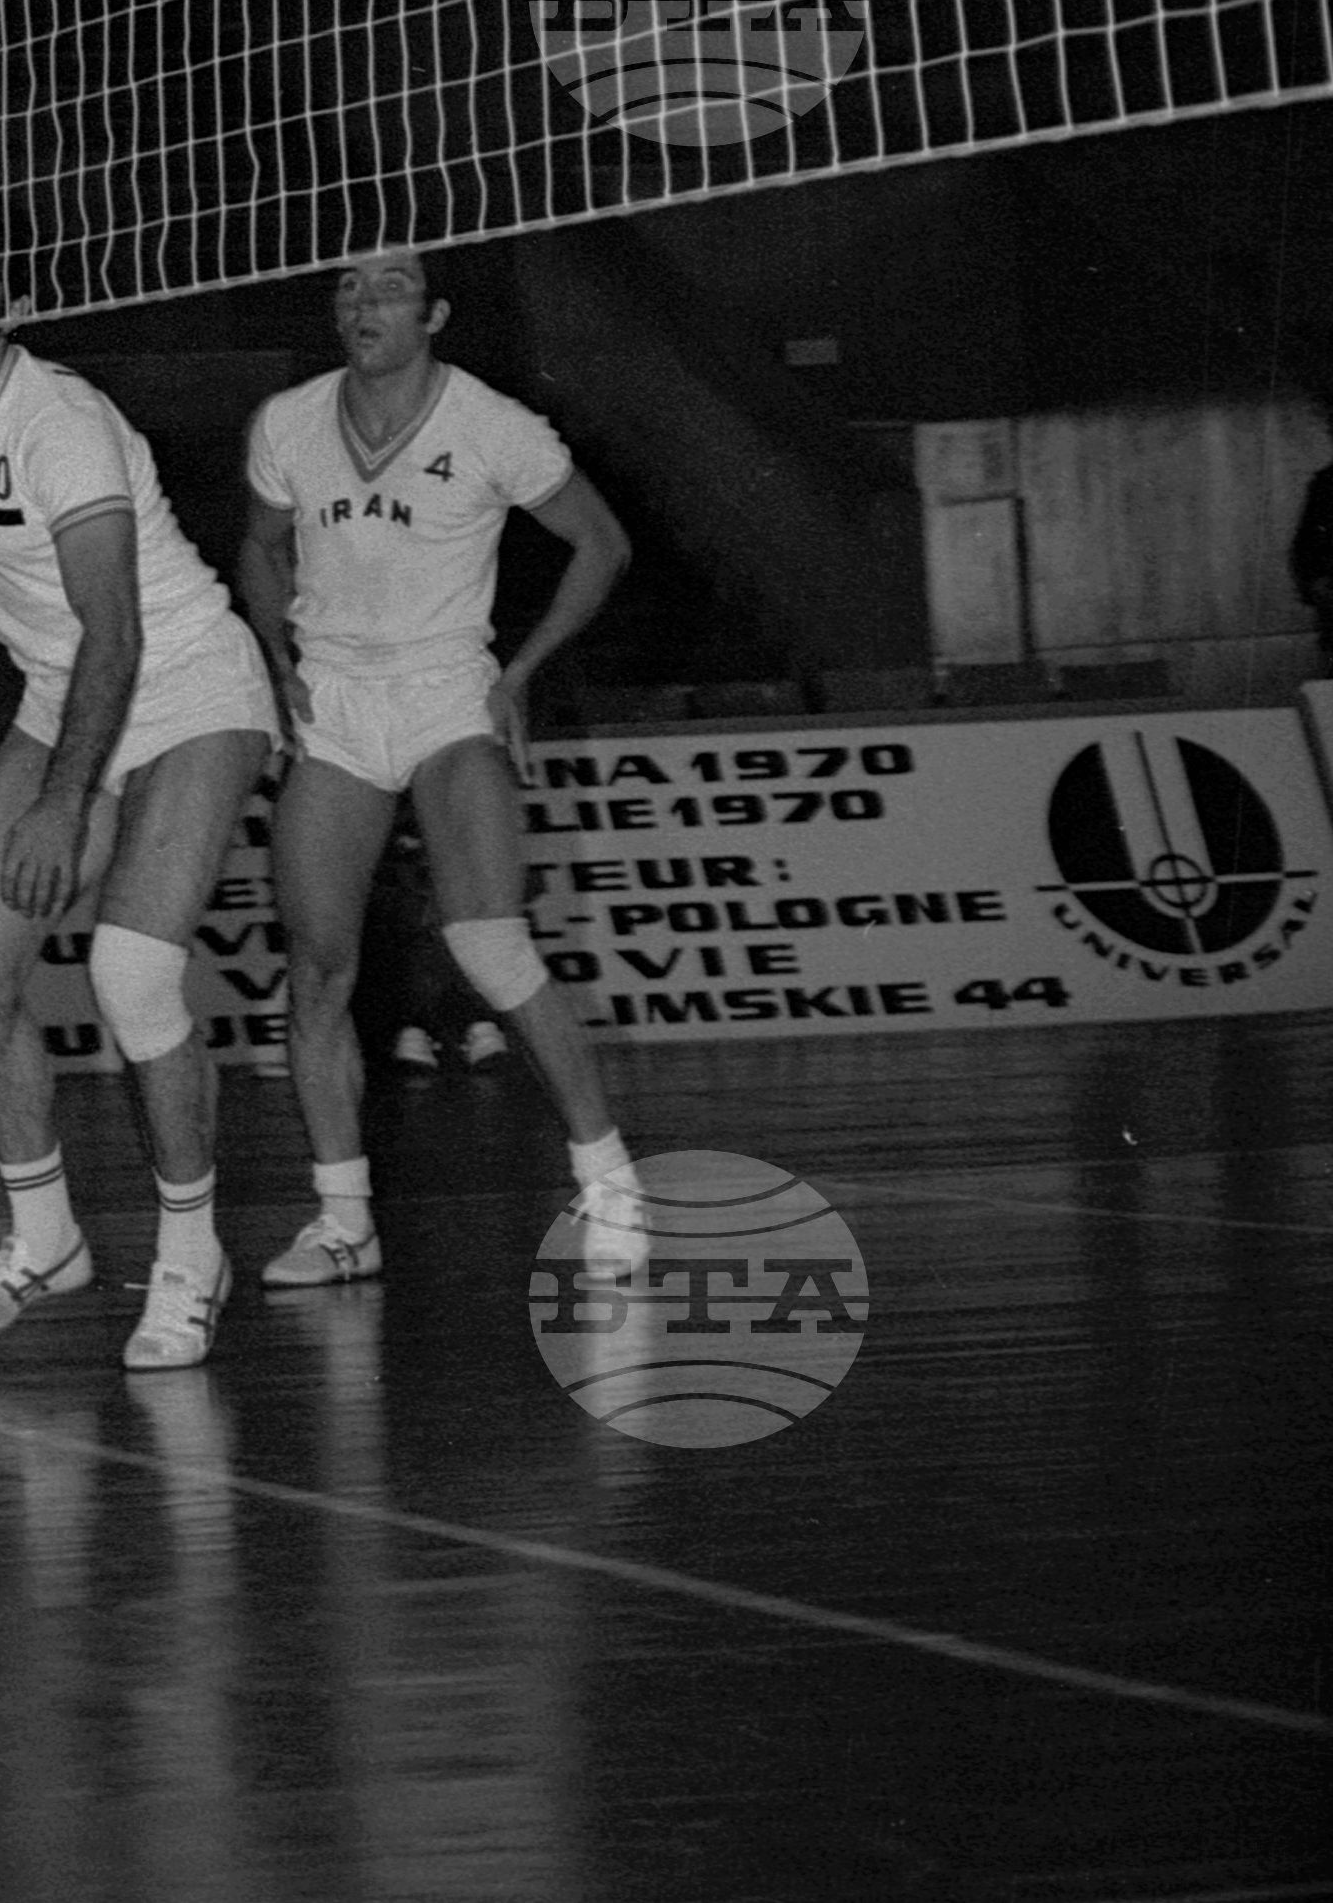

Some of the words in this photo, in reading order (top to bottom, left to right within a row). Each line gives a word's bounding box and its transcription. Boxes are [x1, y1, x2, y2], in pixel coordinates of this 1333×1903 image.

[424, 451, 454, 482] 4
[320, 494, 411, 528] IRAN
[691, 744, 913, 782] 1970
[671, 790, 885, 827] 1970
[1053, 892, 1318, 987] UNIVERSAL
[945, 977, 1070, 1010] 44
